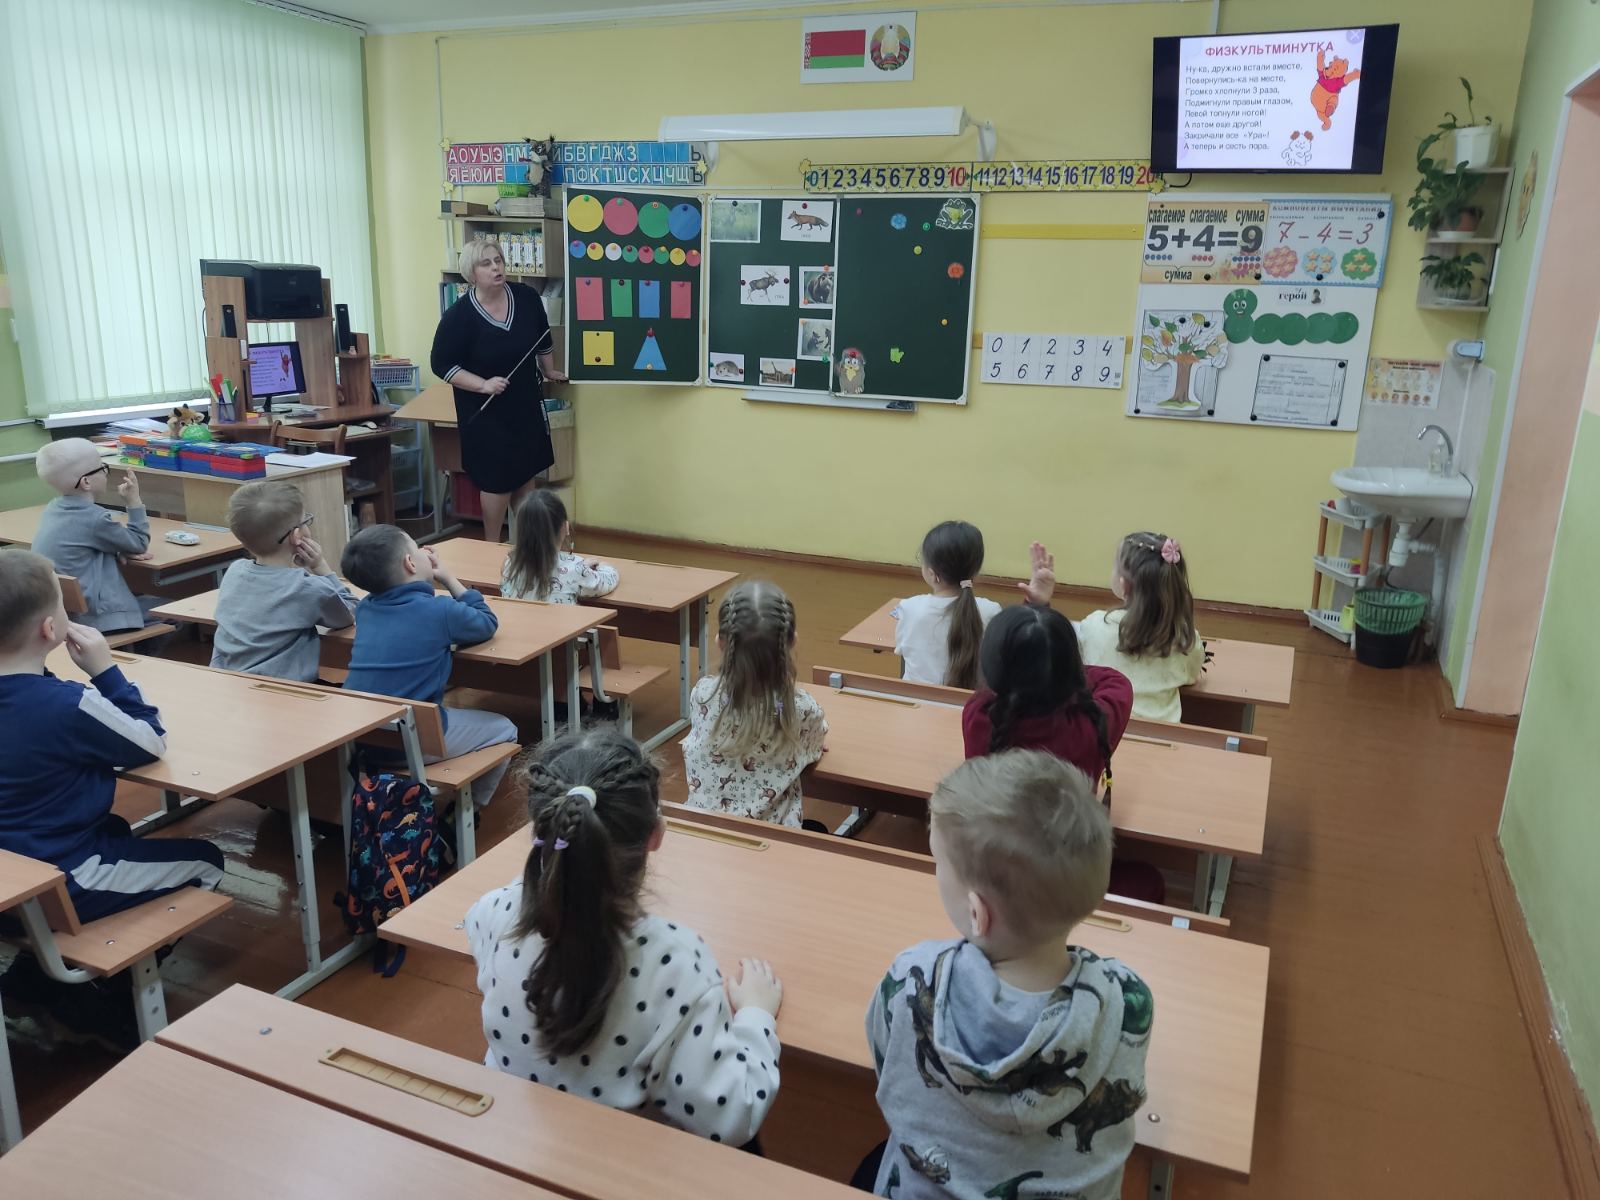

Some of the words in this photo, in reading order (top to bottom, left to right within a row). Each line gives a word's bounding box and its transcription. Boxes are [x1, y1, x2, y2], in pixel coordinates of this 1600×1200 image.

[1205, 41, 1334, 56] ФИЗКУЛЬТМИНУТКА
[1212, 65, 1242, 74] дружно
[1186, 88, 1213, 96] Громко
[1215, 88, 1251, 96] хлопнули
[1185, 99, 1231, 107] Подмигнули
[1185, 110, 1208, 118] Левой
[1210, 110, 1240, 118] топнули
[1232, 120, 1262, 129] другой!
[1185, 132, 1225, 140] Закричали
[1192, 143, 1217, 151] теперь
[1149, 208, 1186, 223] слагаемое
[1190, 209, 1228, 223] слагаемое
[1236, 209, 1265, 226] сумма
[1164, 270, 1192, 283] сумма
[991, 337, 1003, 353] 0
[1021, 338, 1031, 354] 1
[1047, 338, 1057, 355] 2
[1073, 339, 1085, 355] 3
[1102, 340, 1113, 356] 4
[990, 362, 1002, 378] 5
[1017, 363, 1029, 379] 6
[1045, 364, 1055, 380] 7
[1071, 365, 1083, 381] 8
[1099, 366, 1110, 382] 9
